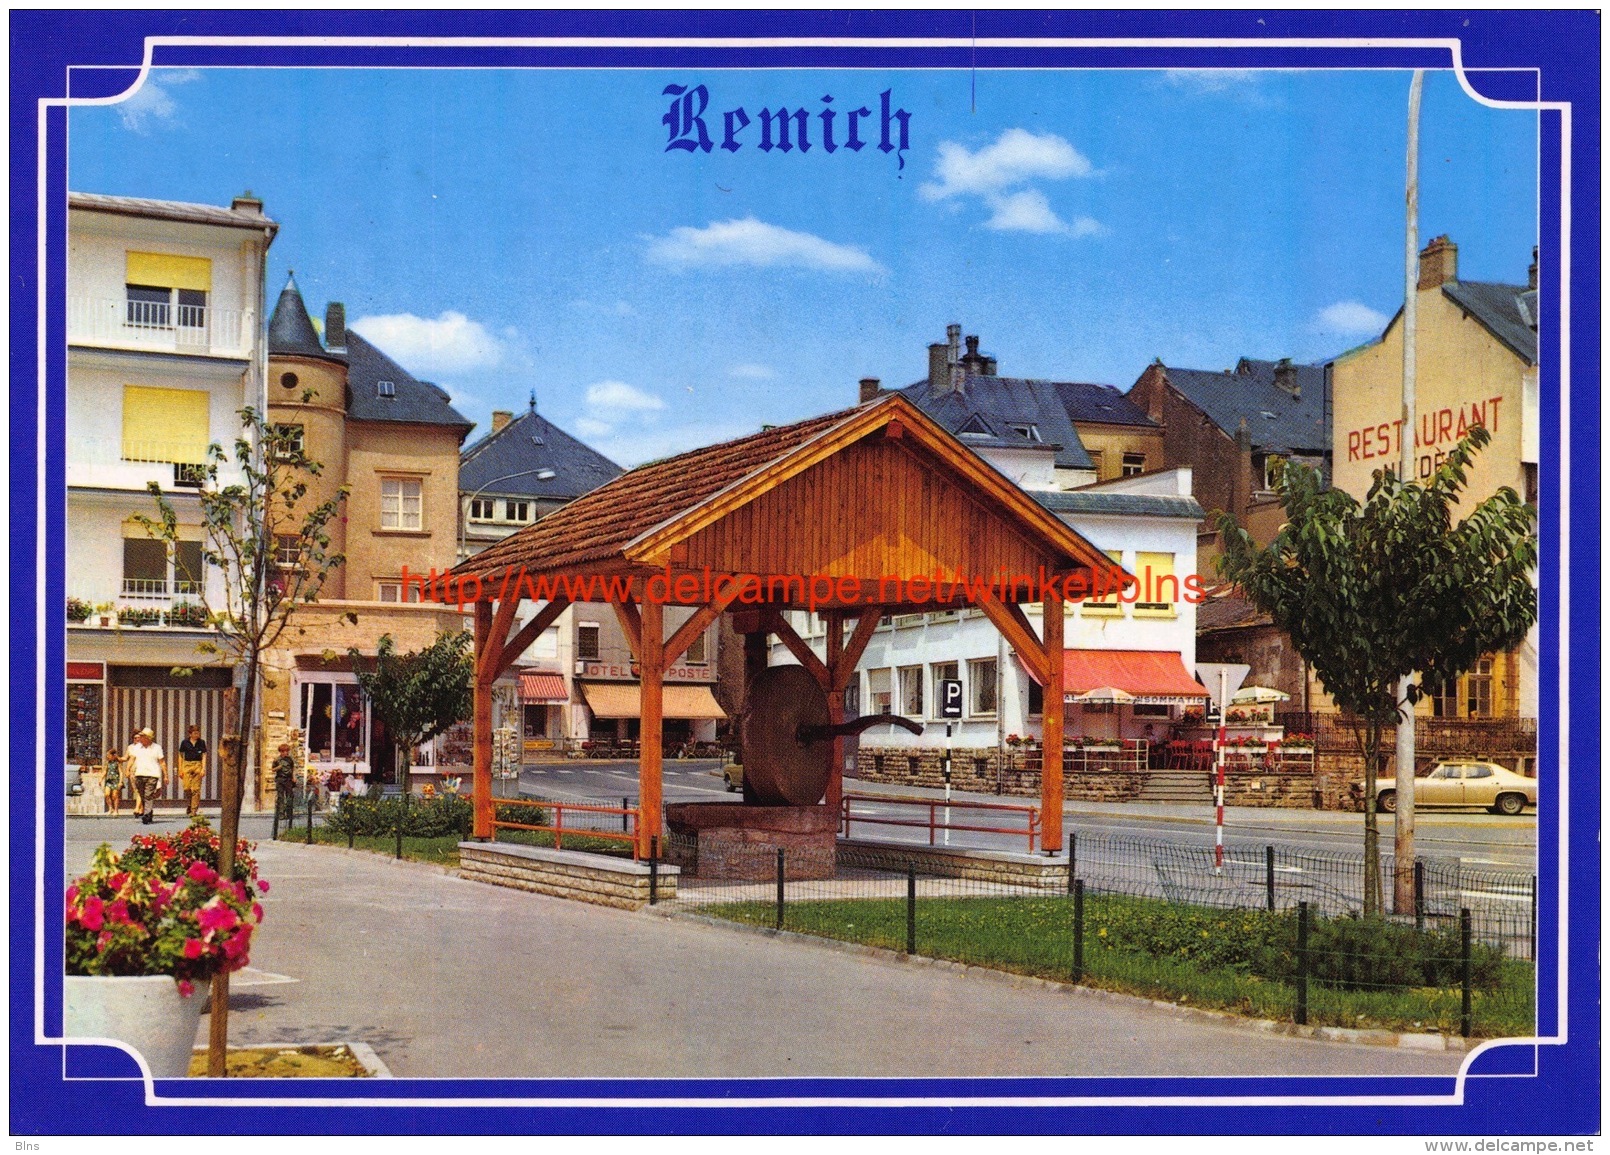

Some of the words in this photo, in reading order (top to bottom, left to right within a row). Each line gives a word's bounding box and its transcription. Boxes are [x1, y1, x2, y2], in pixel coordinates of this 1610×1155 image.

[585, 665, 628, 677] OTEL
[668, 668, 710, 679] POSTE
[947, 682, 961, 704] P
